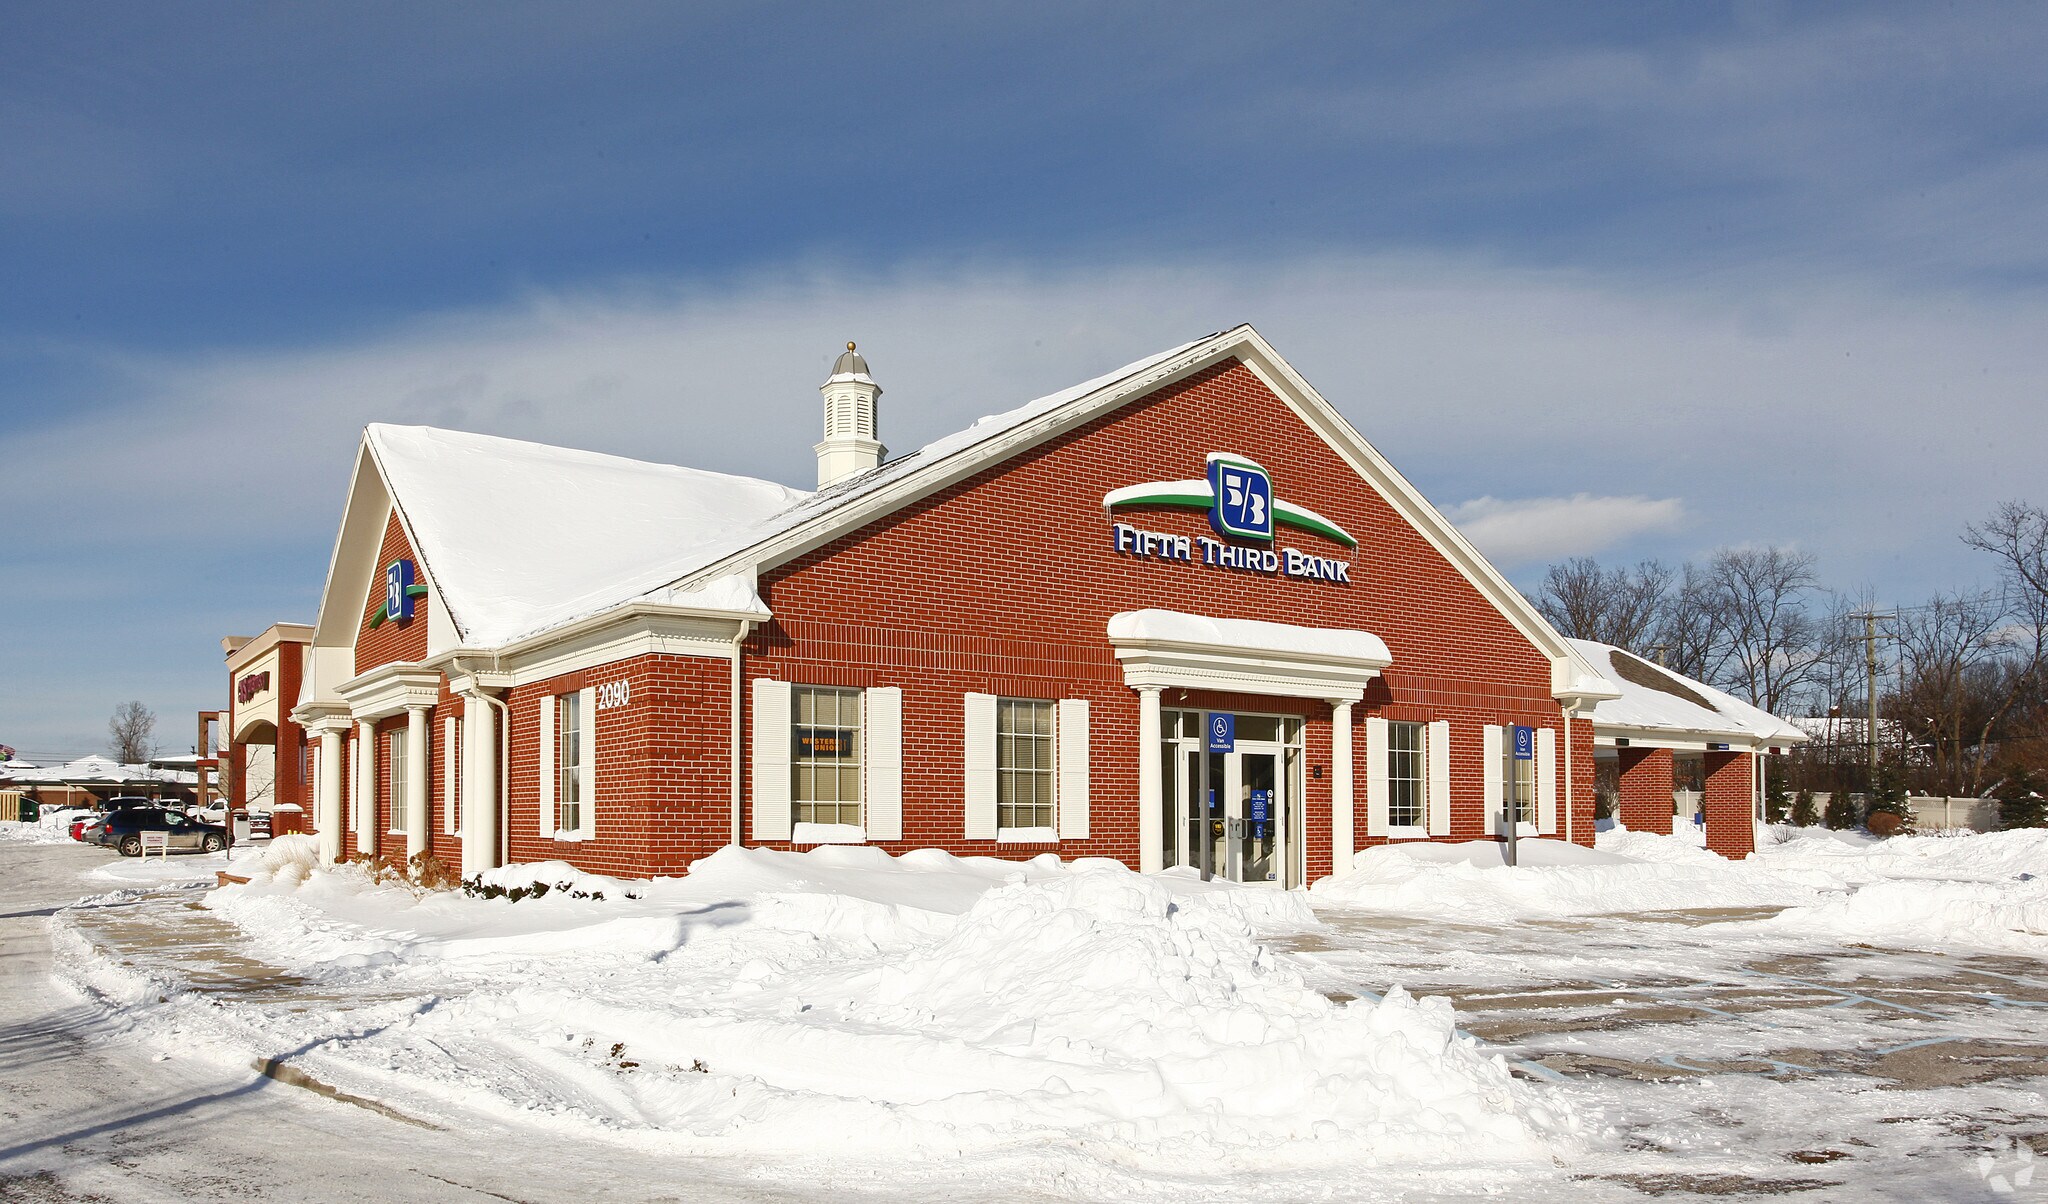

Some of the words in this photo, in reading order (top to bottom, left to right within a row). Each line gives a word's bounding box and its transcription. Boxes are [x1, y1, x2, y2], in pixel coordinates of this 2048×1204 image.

[1113, 523, 1191, 561] FIFTH
[1197, 536, 1278, 572] THIRD
[1282, 547, 1350, 583] BANK
[598, 679, 630, 710] 2090
